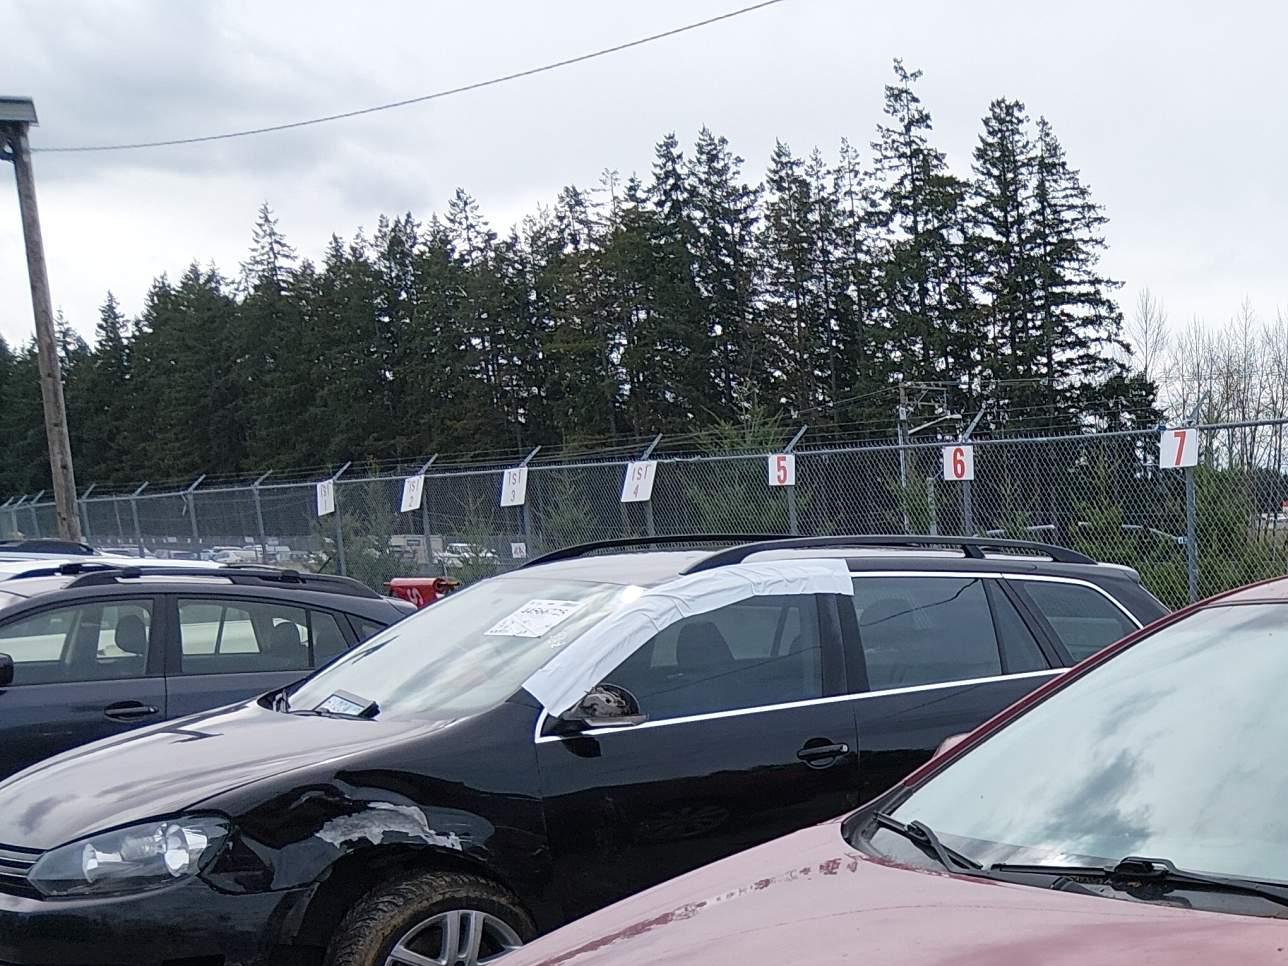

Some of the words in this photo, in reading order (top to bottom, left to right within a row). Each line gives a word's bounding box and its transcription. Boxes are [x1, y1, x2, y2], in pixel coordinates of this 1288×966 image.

[1173, 430, 1187, 466] 7
[776, 455, 788, 484] 5
[952, 447, 966, 479] 6
[510, 489, 516, 502] 3
[632, 484, 640, 498] 4
